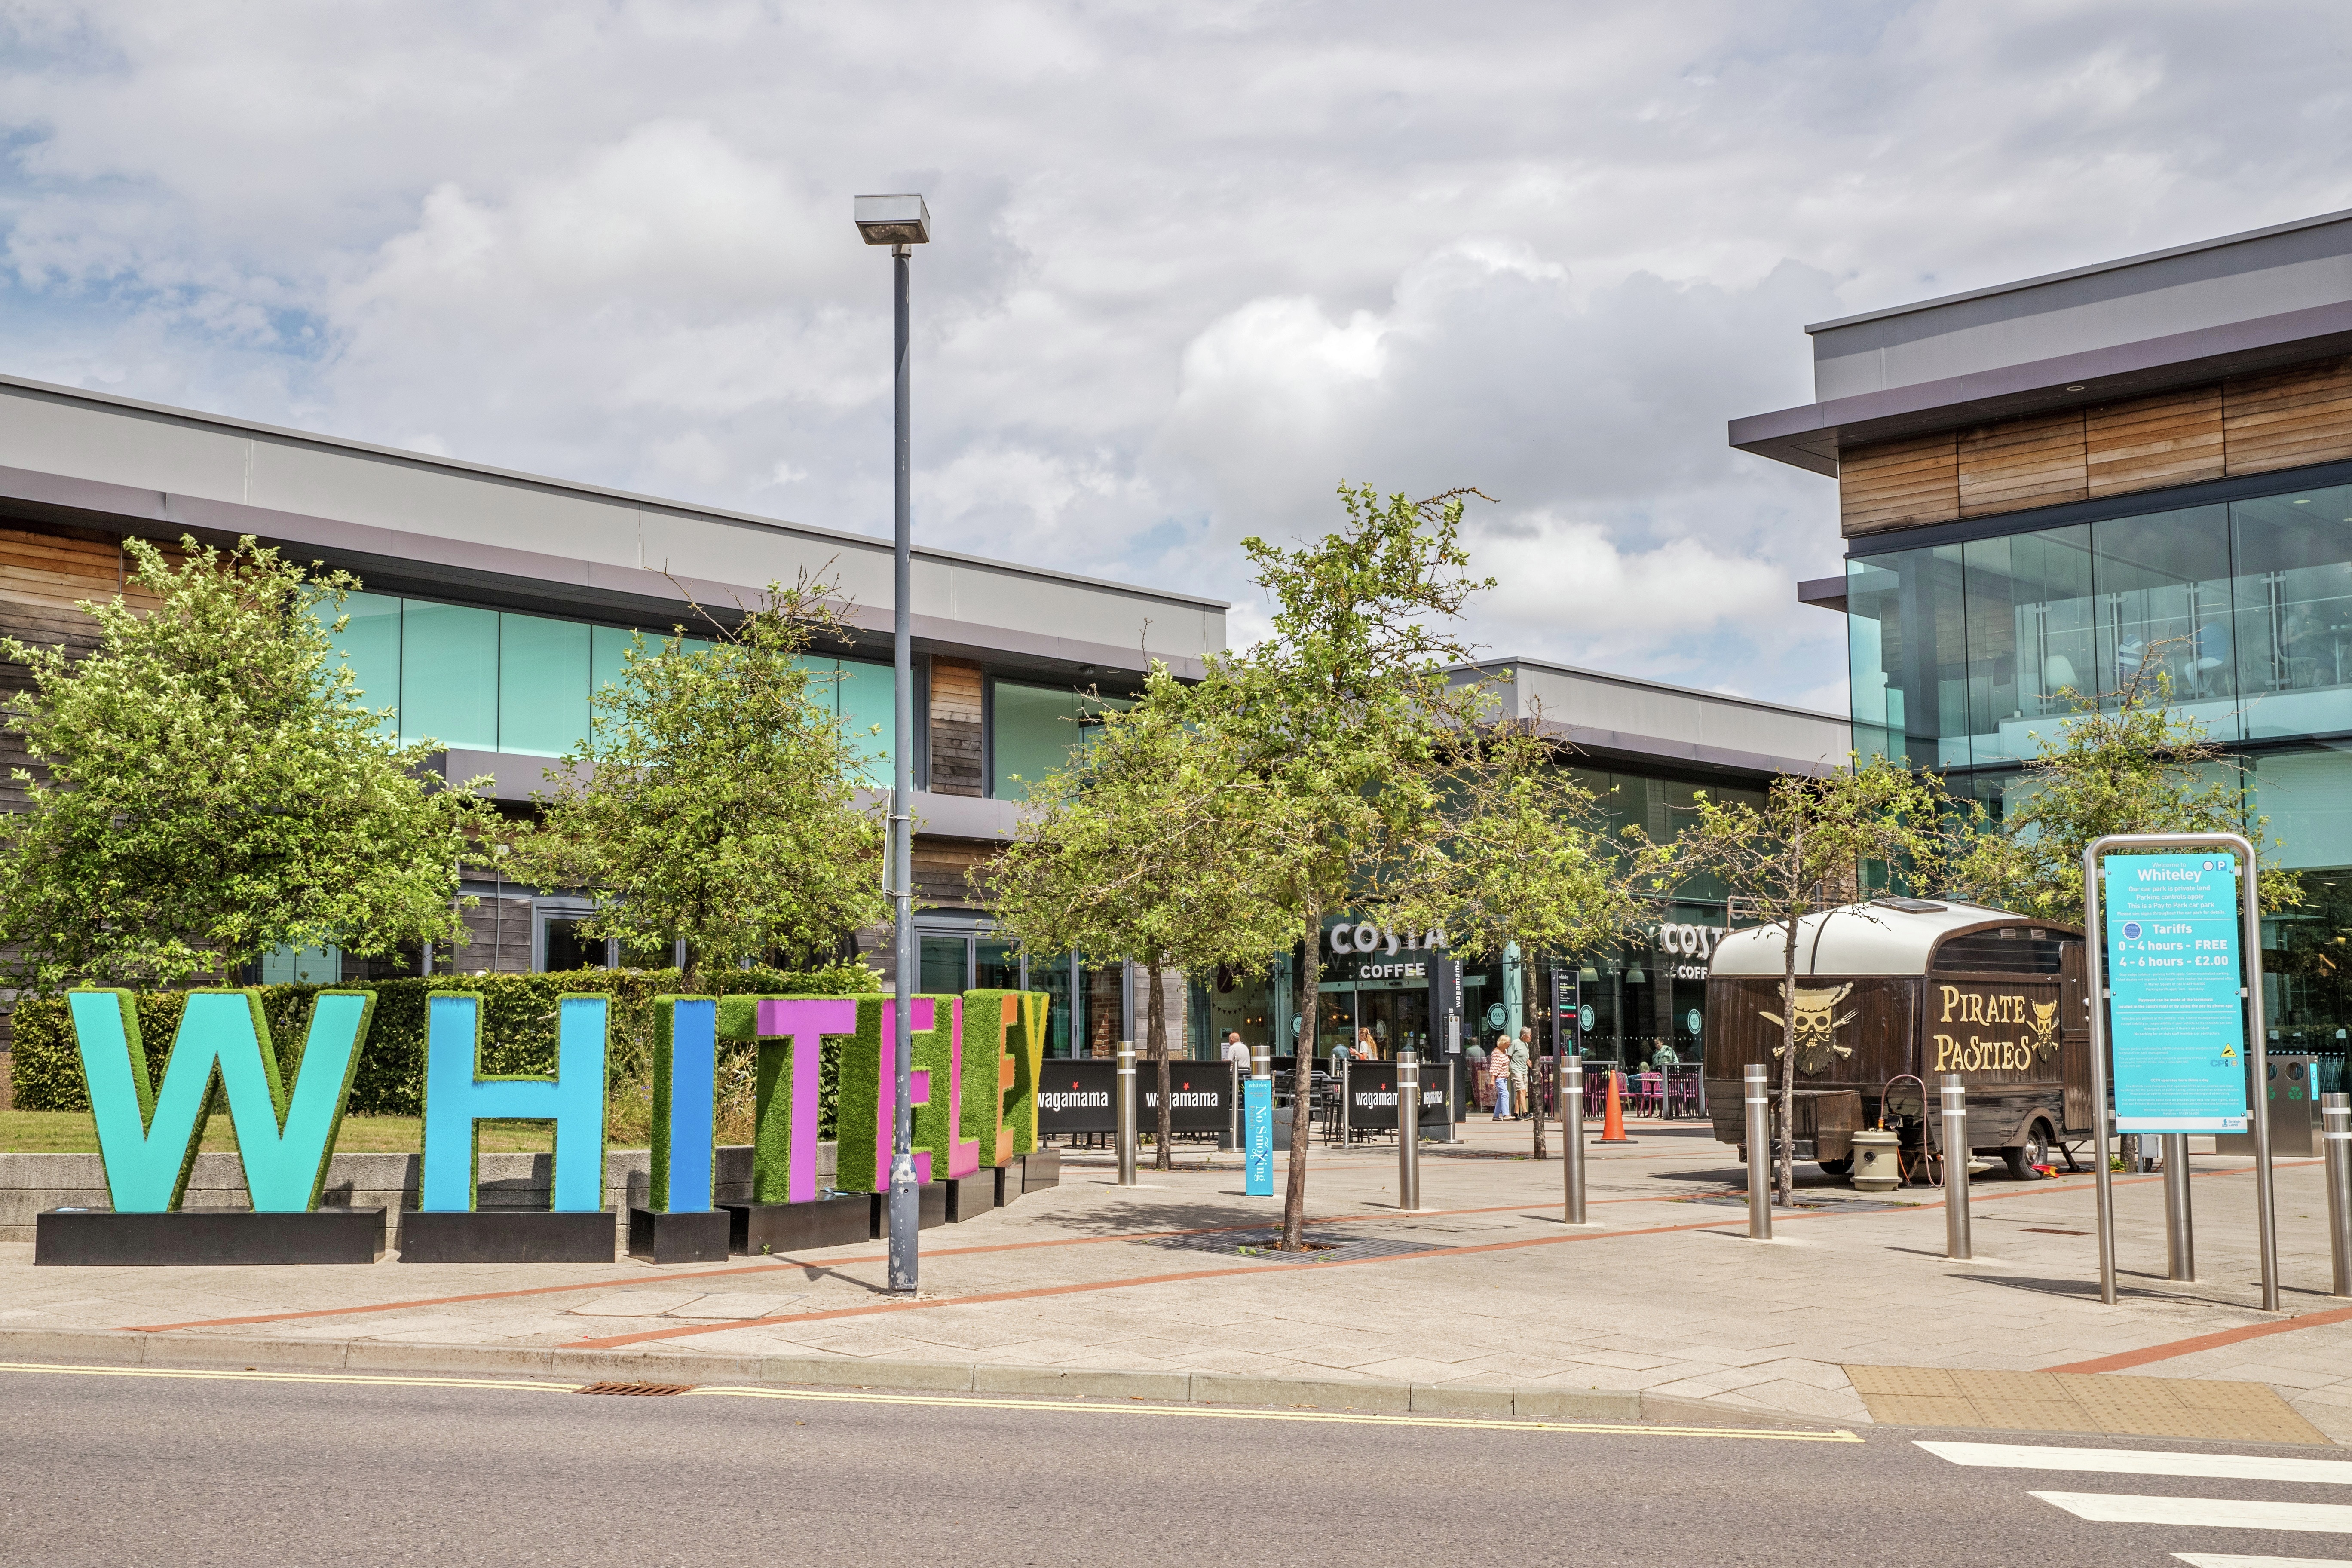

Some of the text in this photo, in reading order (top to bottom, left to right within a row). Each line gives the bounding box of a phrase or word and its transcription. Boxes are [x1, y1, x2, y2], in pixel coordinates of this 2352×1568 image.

[2218, 861, 2225, 870] P
[2137, 868, 2202, 883] Whiteley
[2153, 924, 2192, 934] Tariffs
[1660, 922, 1726, 960] COST
[2119, 941, 2125, 951] 0
[2137, 941, 2144, 950] 4
[2148, 940, 2183, 950] hours
[2195, 940, 2227, 949] FREE
[2119, 957, 2126, 966] 4
[2138, 956, 2145, 966] 6
[2149, 956, 2183, 966] hours
[2195, 956, 2228, 965] £2.00
[1360, 962, 1425, 978] COFFEE
[1678, 965, 1707, 980] COFF
[1490, 1004, 1501, 1013] AVAILABLE
[1939, 986, 2025, 1026] PIRATE
[1933, 1035, 2031, 1072] PASTIES
[1037, 1091, 1108, 1112] wagamama
[1146, 1092, 1218, 1111] wamama
[1356, 1092, 1398, 1109] wagamam
[1424, 1091, 1442, 1108] wagamama
[1256, 1105, 1267, 1123] No
